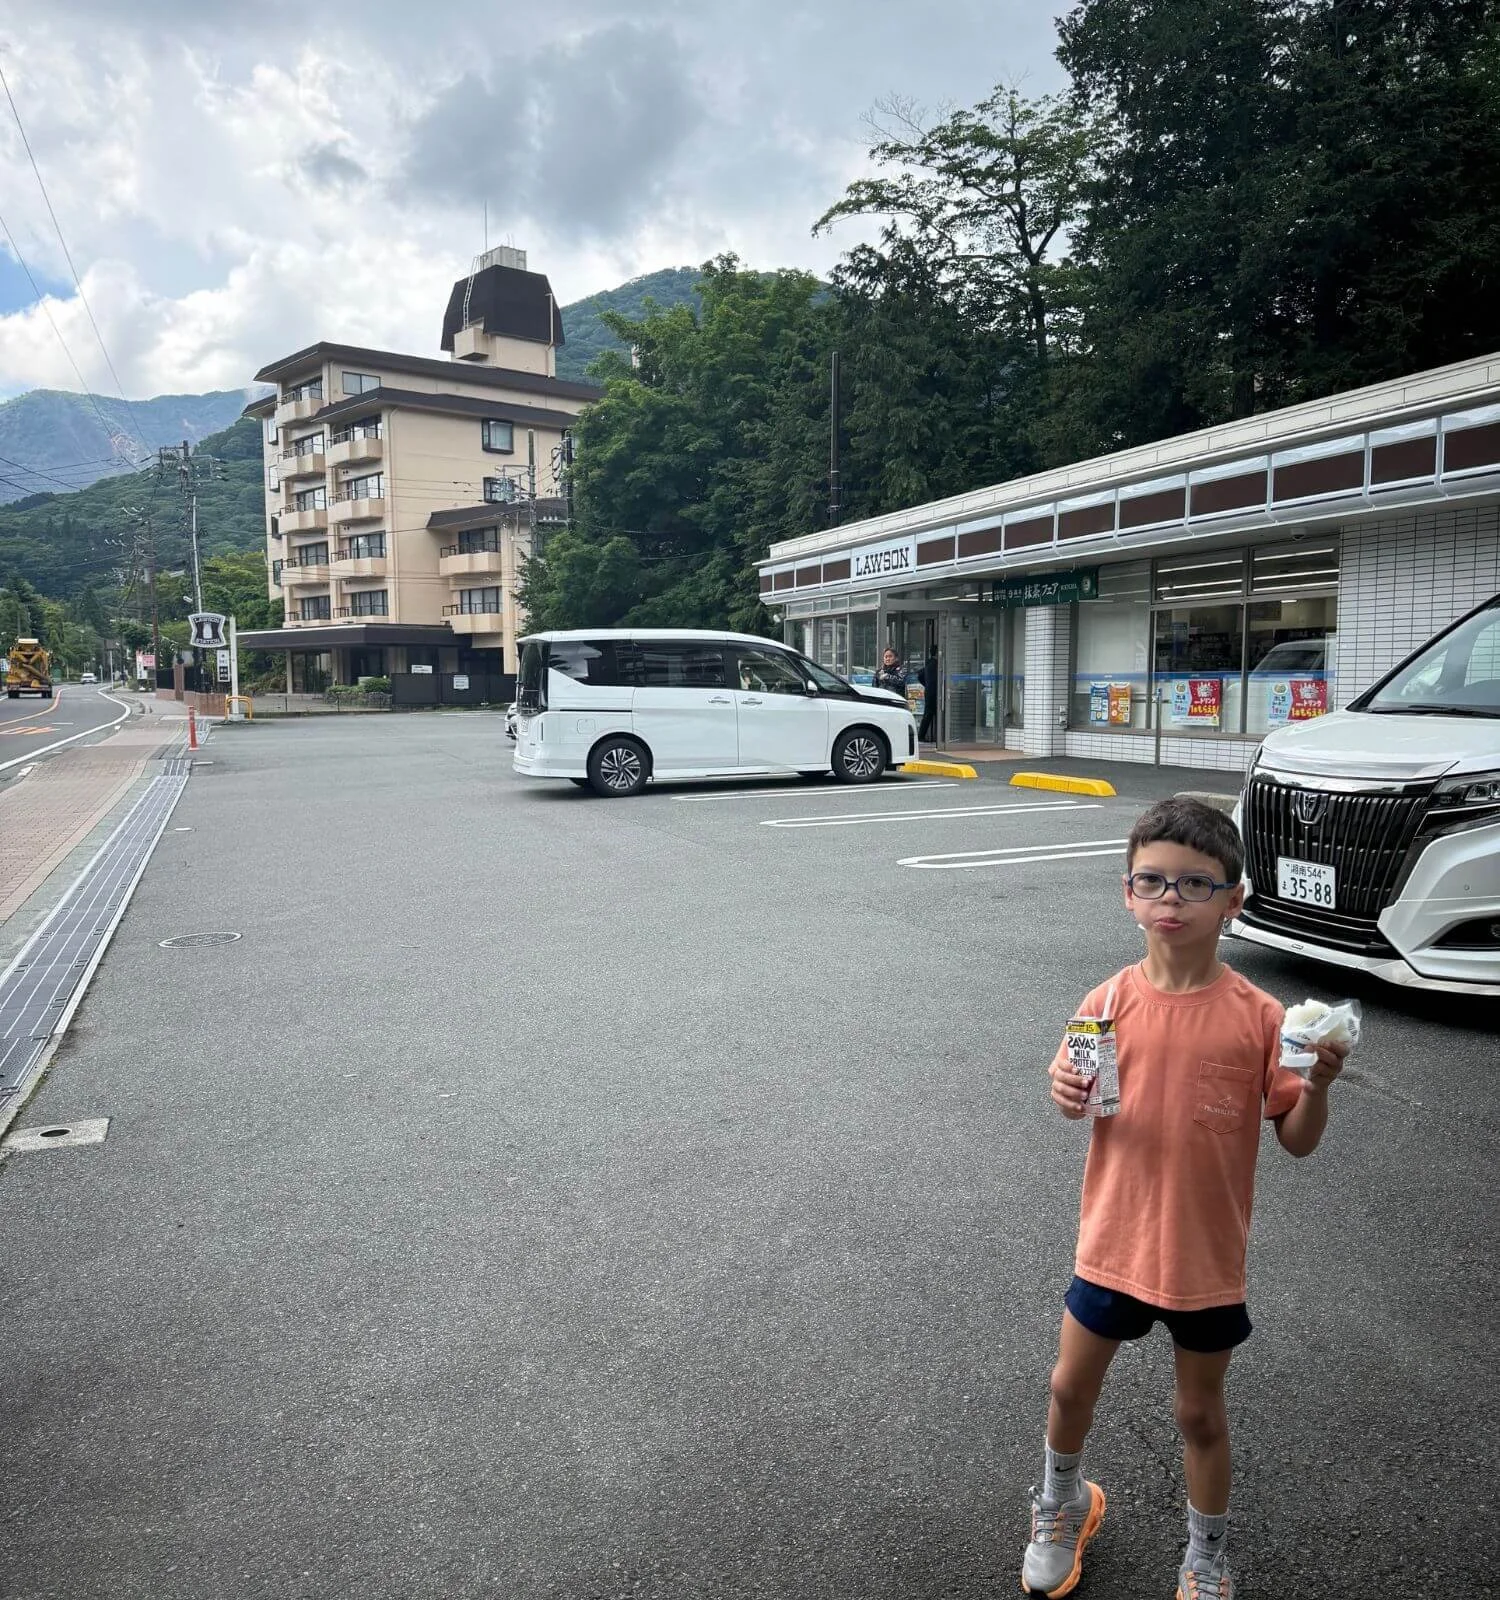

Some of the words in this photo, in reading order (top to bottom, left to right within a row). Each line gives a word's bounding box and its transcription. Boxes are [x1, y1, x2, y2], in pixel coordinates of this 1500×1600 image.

[856, 547, 909, 576] LAWSON
[1290, 863, 1307, 877] 湘南
[1307, 866, 1322, 879] 544
[1290, 877, 1332, 905] 35-88
[1068, 1036, 1096, 1050] SAVAS
[1074, 1049, 1090, 1059] MILK
[1070, 1057, 1097, 1069] PROTEIN
